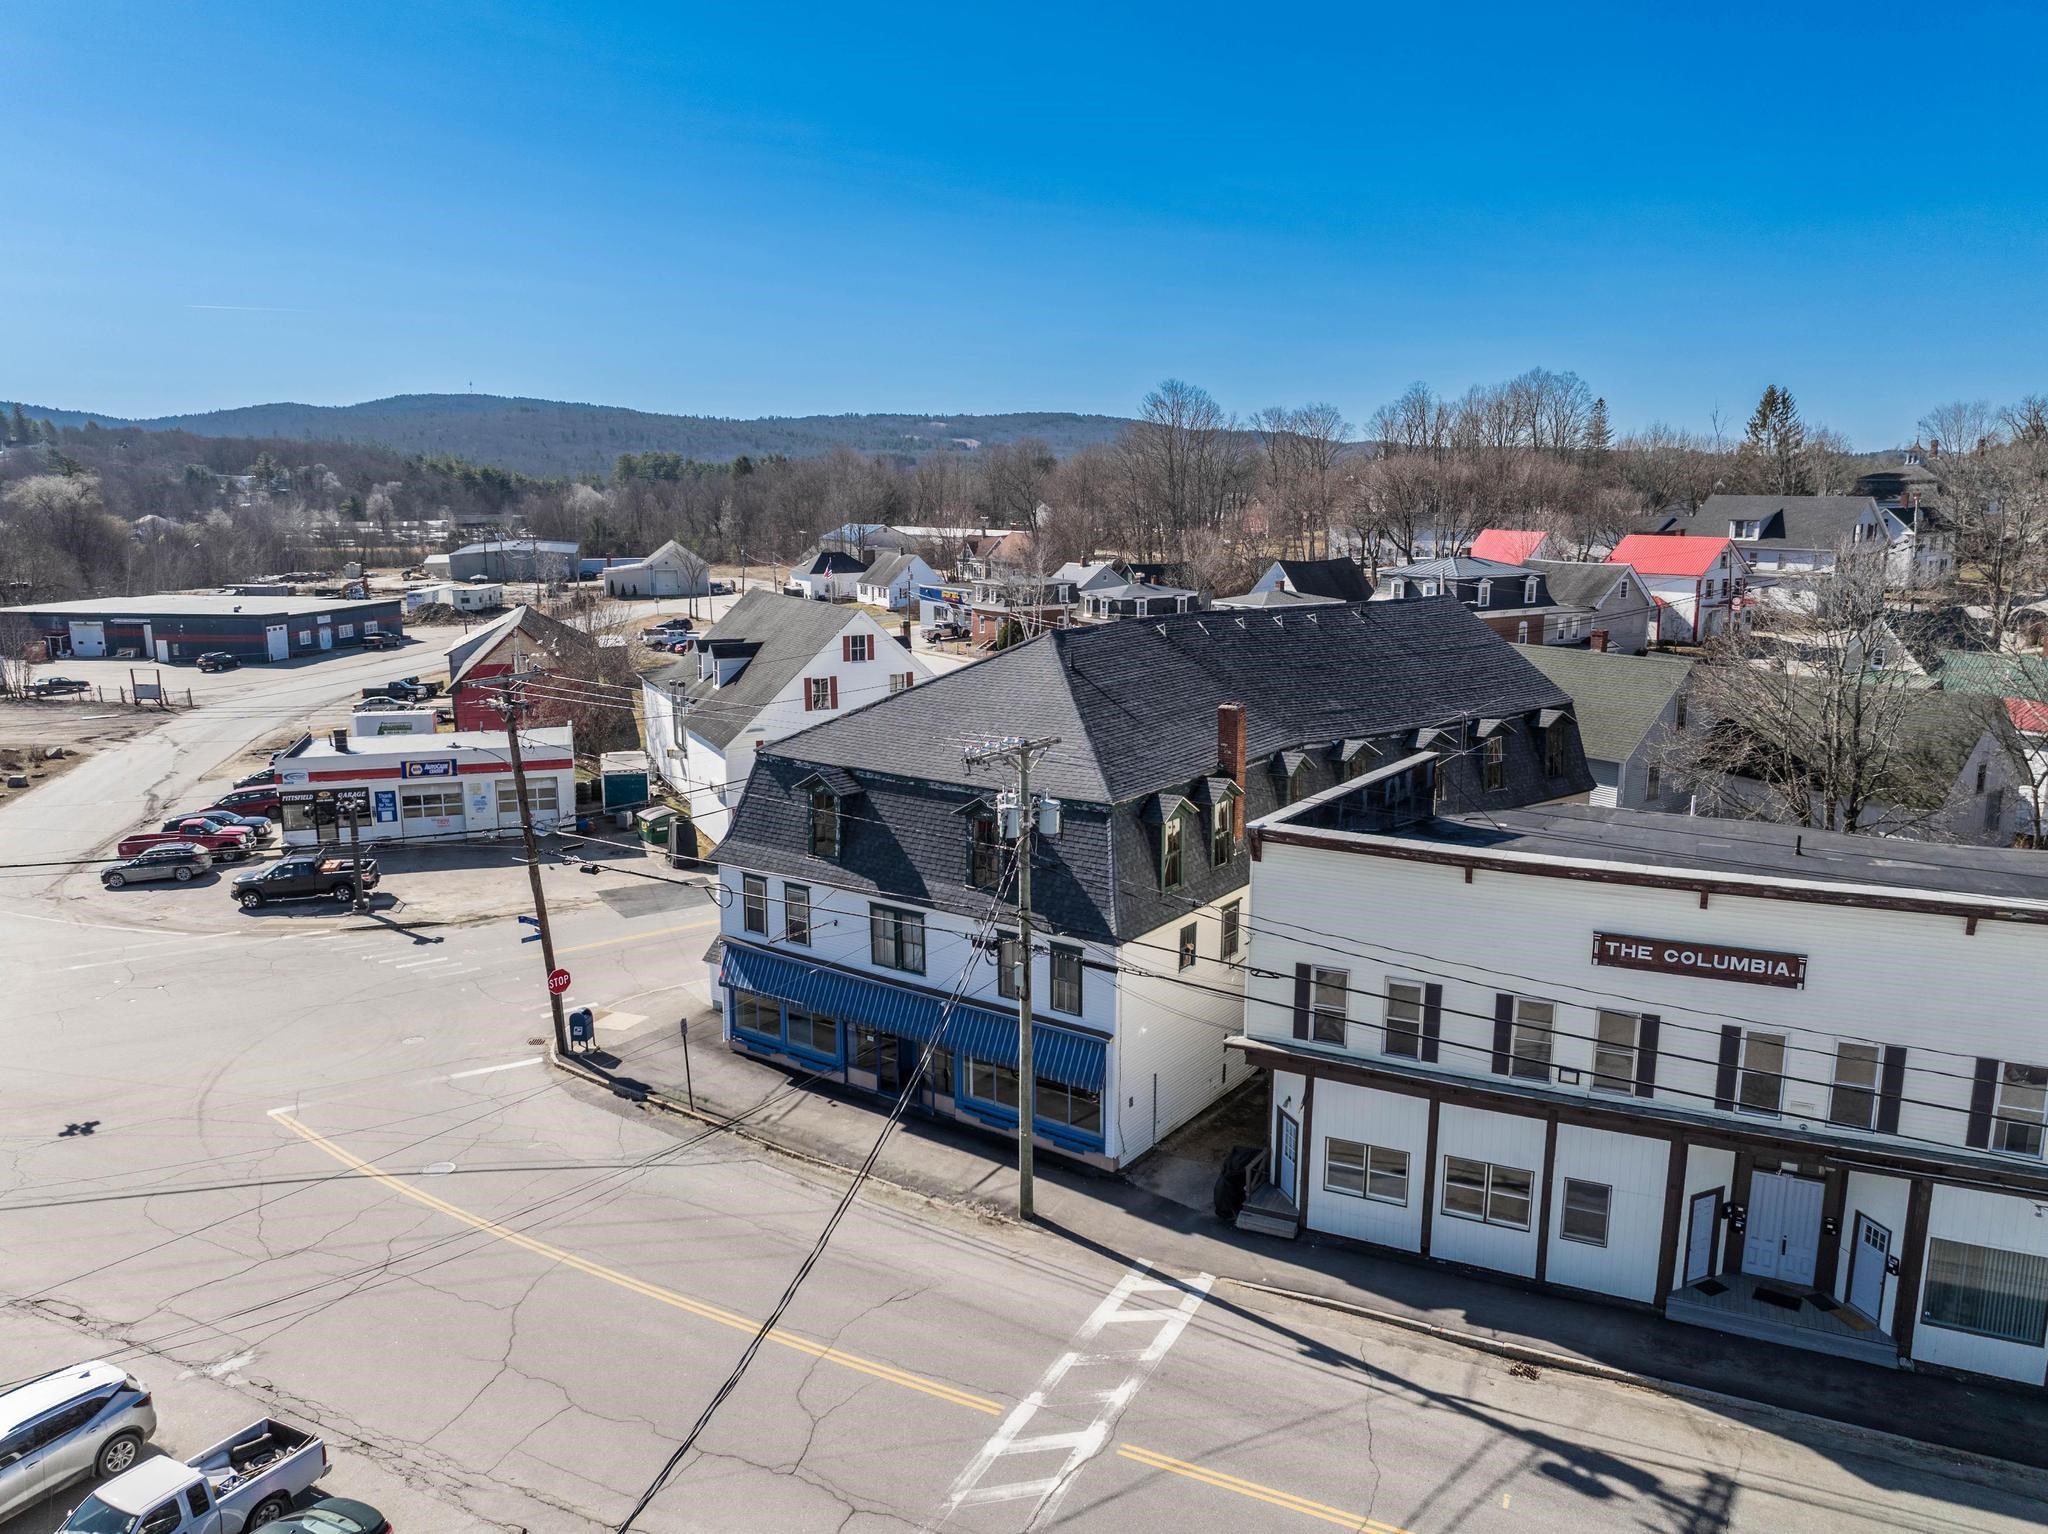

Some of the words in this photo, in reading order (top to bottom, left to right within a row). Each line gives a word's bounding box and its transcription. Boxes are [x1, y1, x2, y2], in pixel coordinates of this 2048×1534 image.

[282, 794, 314, 802] PITTSFIELD
[337, 791, 366, 799] GARAGE
[1605, 941, 1653, 961] THE
[549, 975, 568, 989] STOP
